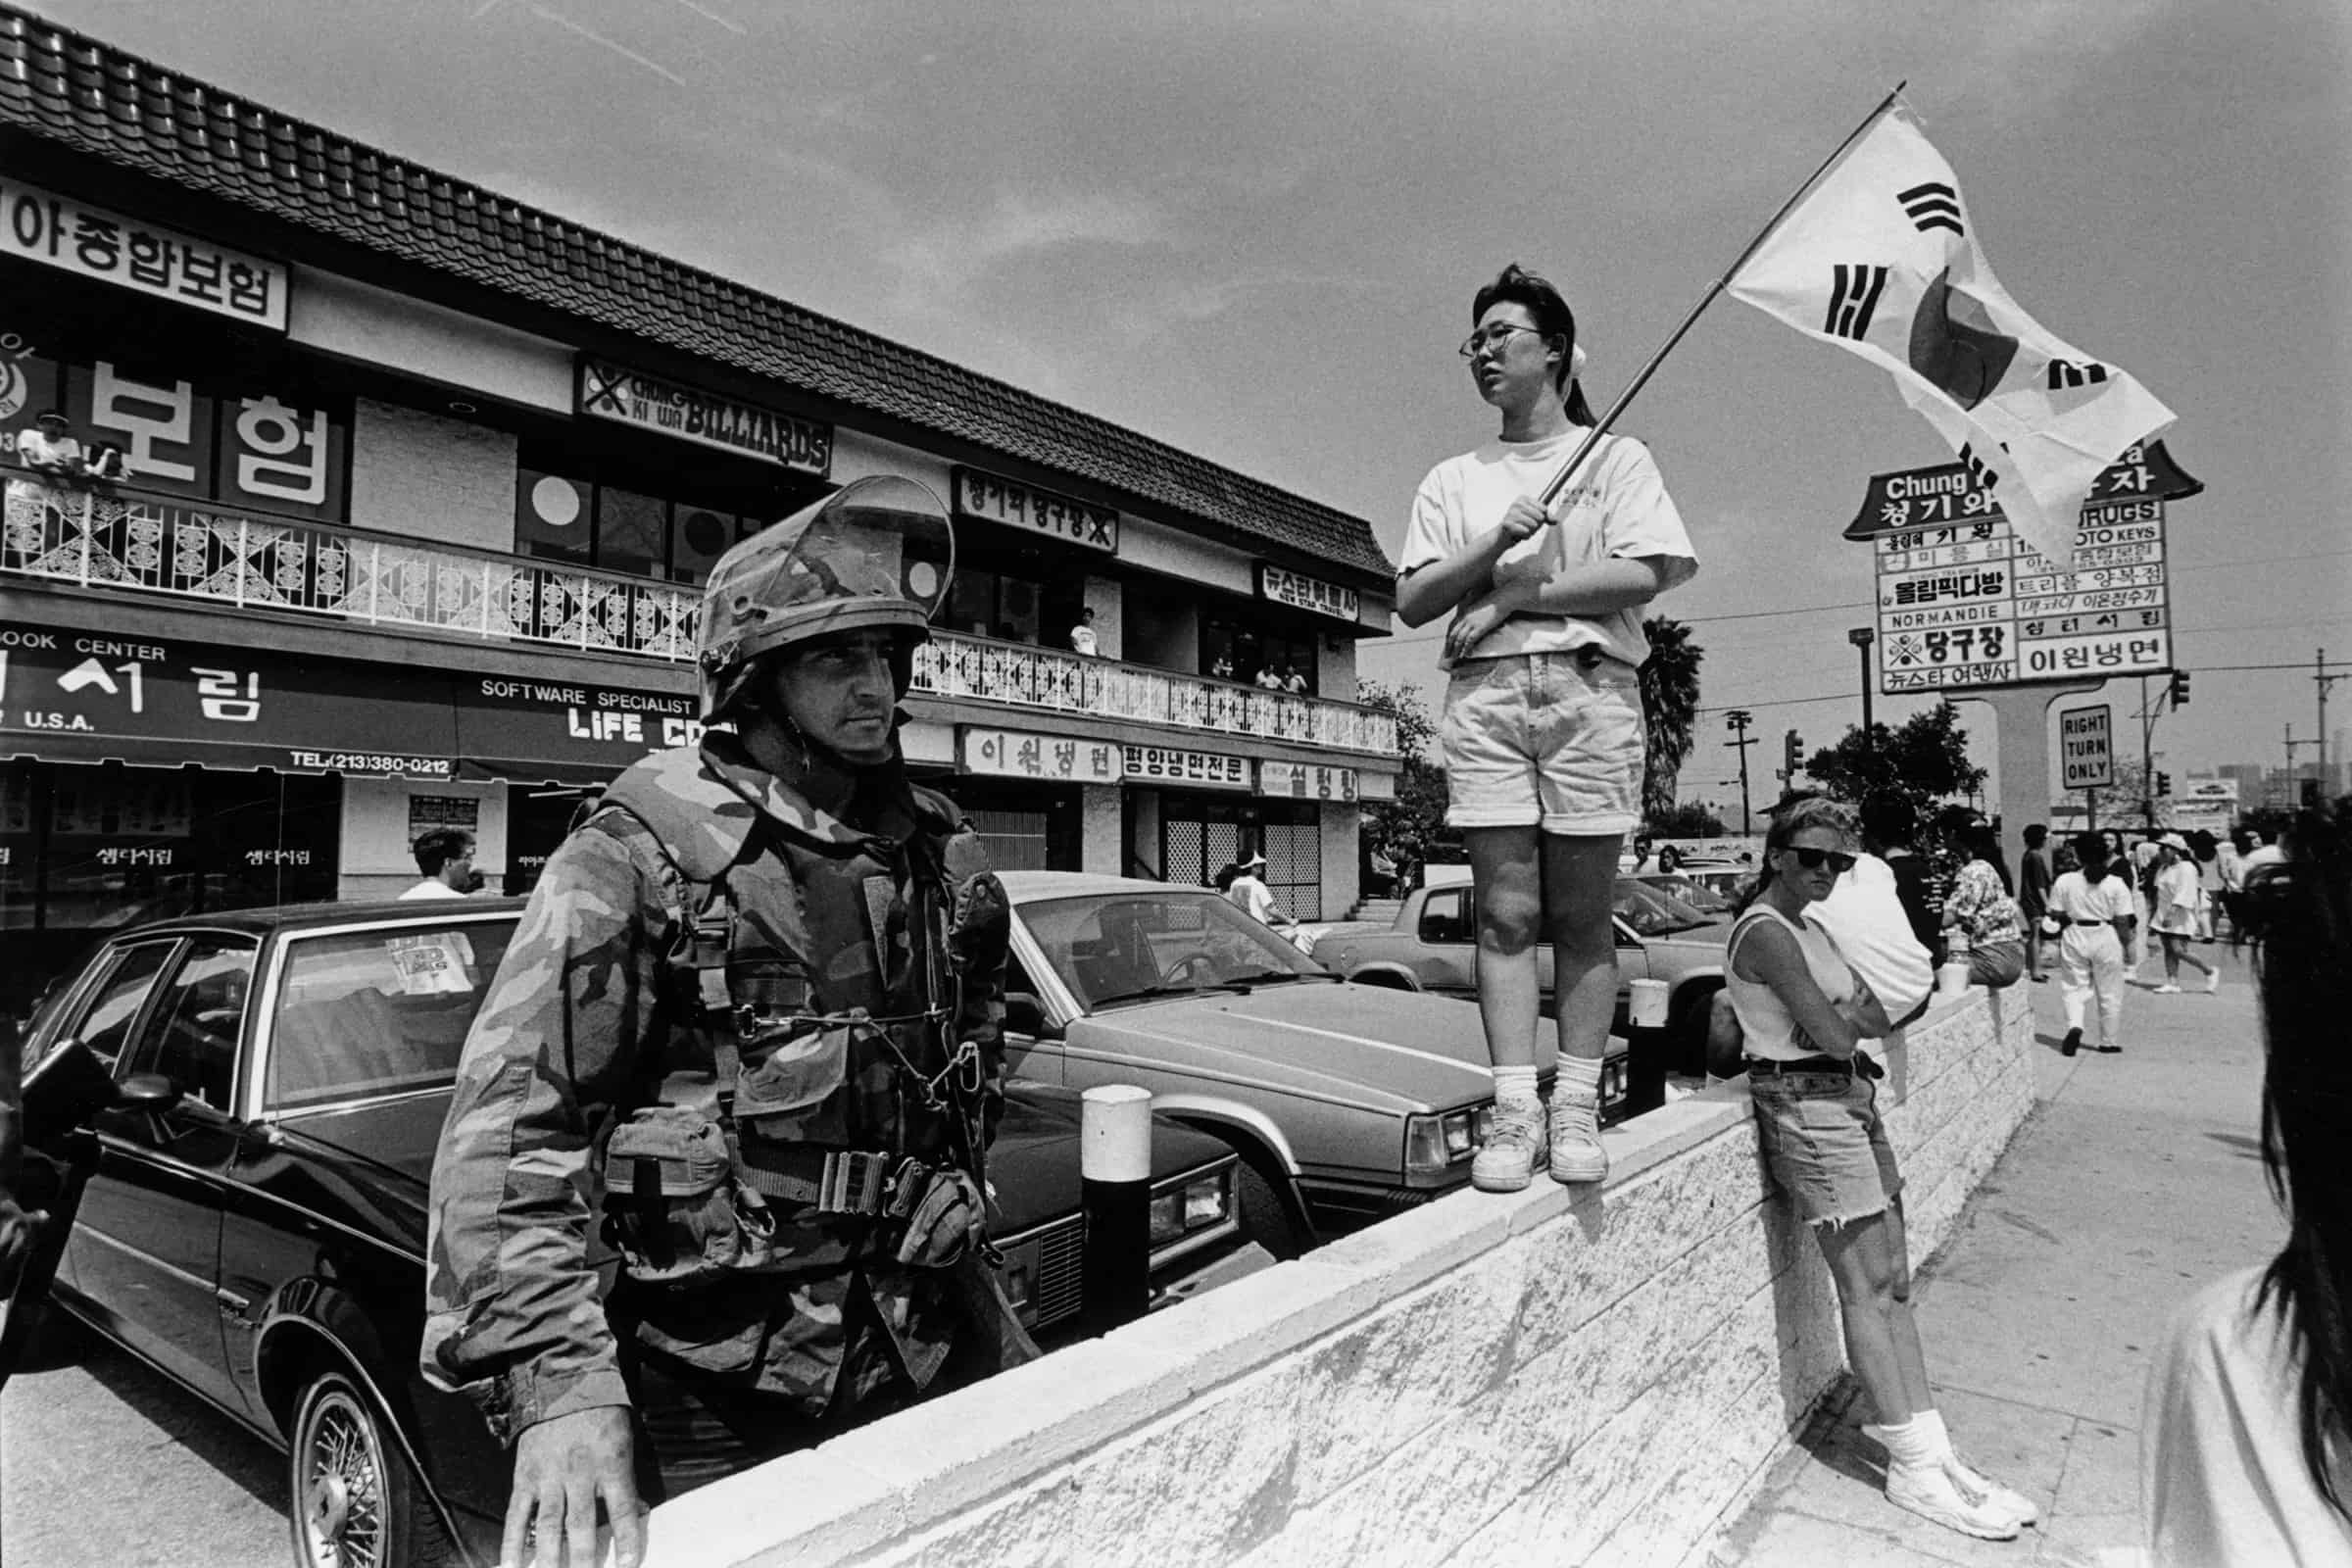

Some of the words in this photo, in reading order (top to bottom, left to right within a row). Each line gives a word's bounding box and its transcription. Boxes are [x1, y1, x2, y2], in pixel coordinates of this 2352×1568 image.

[13, 194, 270, 317] 아종합보험
[92, 361, 328, 506] 보험
[686, 398, 829, 468] BILLIARDS
[1886, 472, 1968, 500] Chung
[1880, 488, 1999, 526] 청기와
[2117, 526, 2156, 542] KEYS
[1894, 571, 2004, 605] 올림픽다방
[1891, 605, 1998, 628] NORMANDIE
[74, 638, 166, 662] CENTER
[1925, 626, 2005, 662] 당구장
[2030, 639, 2159, 671] 이원냉면
[598, 693, 692, 714] SPECIALIST
[24, 710, 95, 731] U.S.A.
[568, 708, 643, 743] LIFE
[2065, 714, 2106, 734] RIGHT
[981, 733, 1109, 777] 이원냉면
[2067, 738, 2106, 757] TURN
[1125, 747, 1242, 783] 평양냉면전문
[2068, 761, 2106, 780] ONLY
